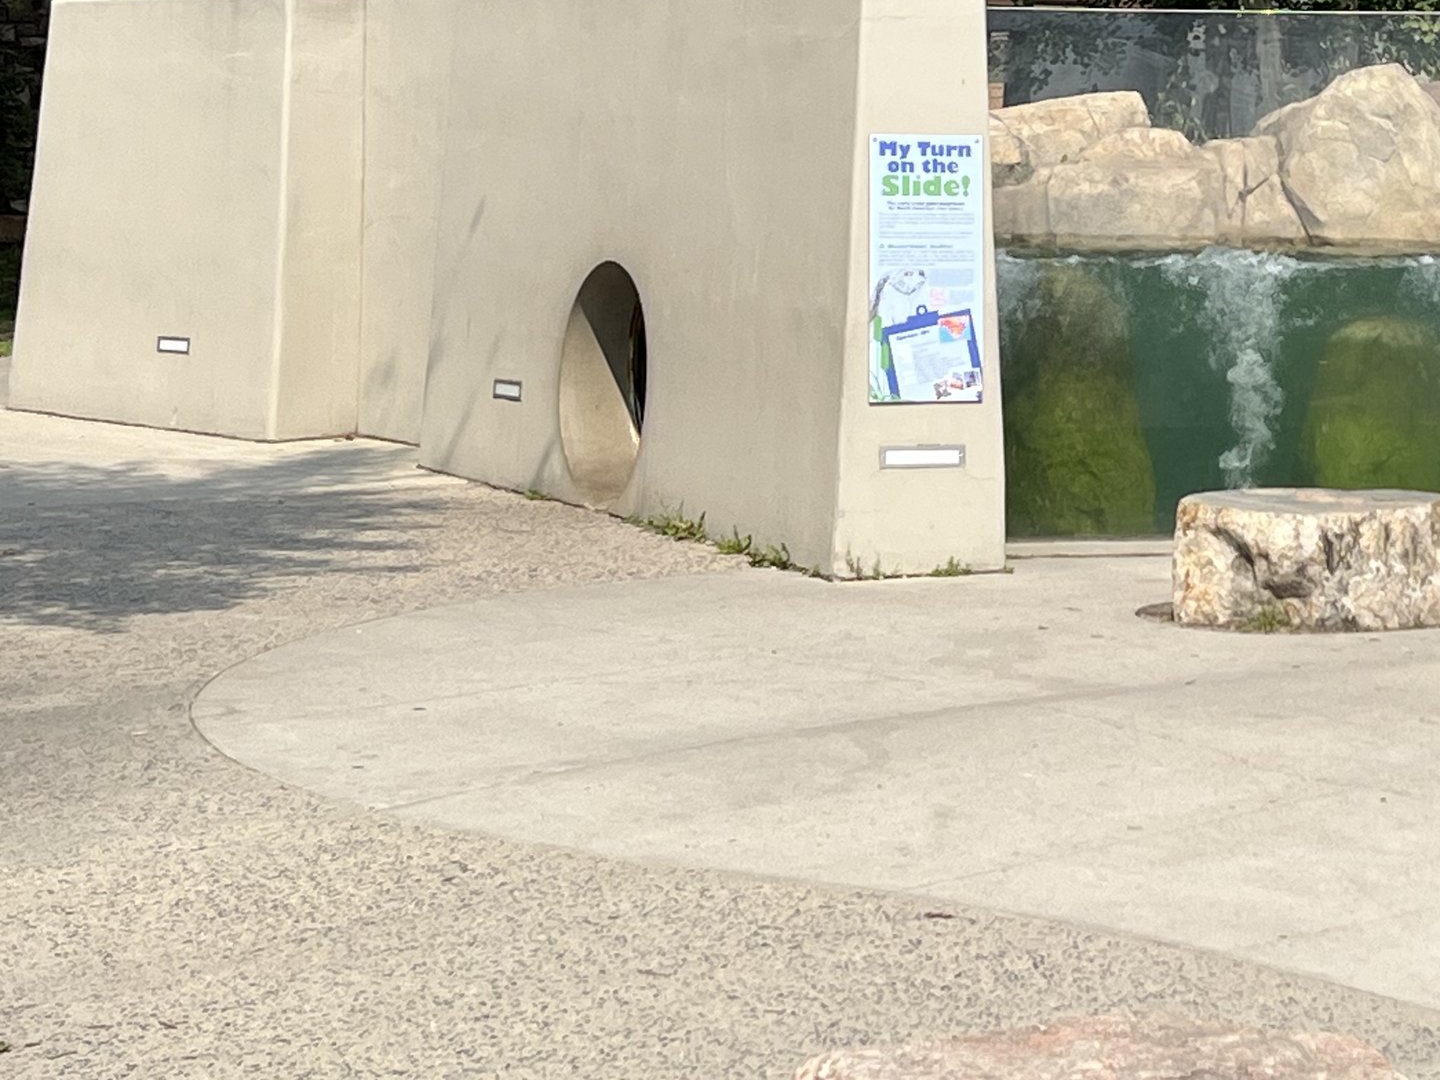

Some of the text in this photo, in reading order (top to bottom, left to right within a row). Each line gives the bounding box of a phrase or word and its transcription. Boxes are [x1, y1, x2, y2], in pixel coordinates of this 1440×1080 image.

[879, 140, 972, 159] My Turn
[887, 158, 959, 173] on the
[881, 174, 971, 197] Slide!
